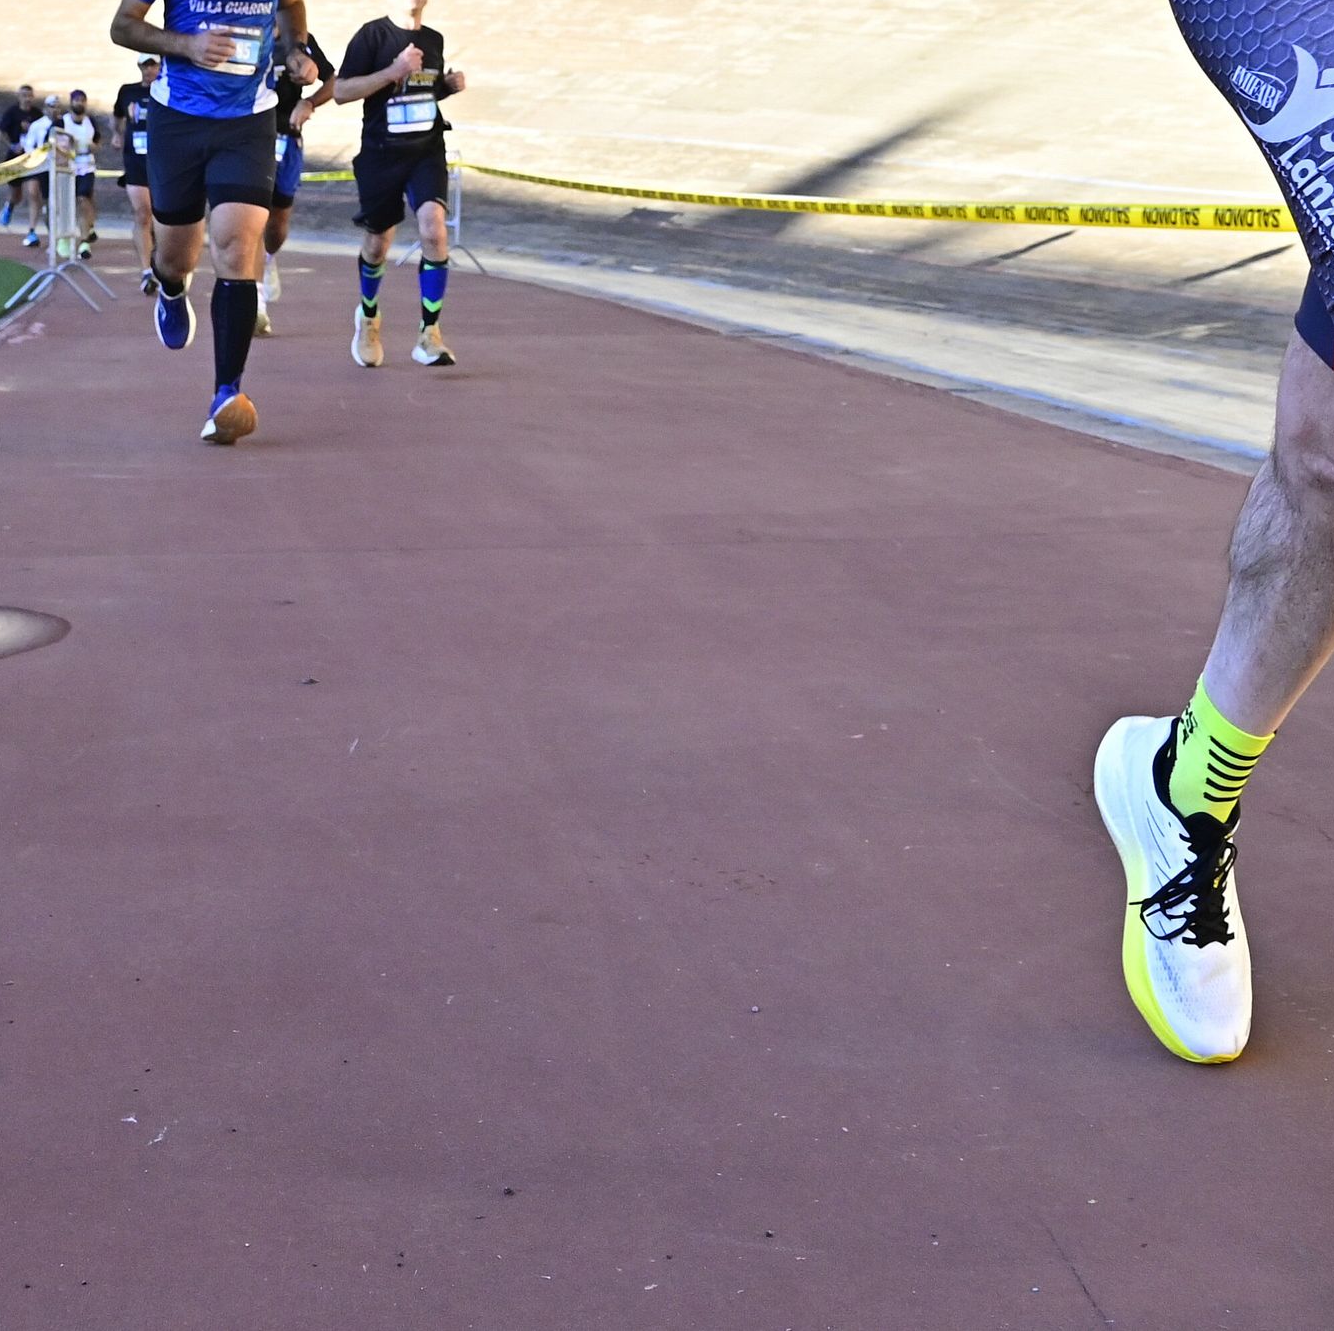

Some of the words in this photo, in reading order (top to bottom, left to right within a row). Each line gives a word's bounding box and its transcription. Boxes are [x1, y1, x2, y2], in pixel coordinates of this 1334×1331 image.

[1080, 206, 1130, 225] SALOMON
[1142, 207, 1200, 226] SALOMON
[1214, 208, 1281, 228] SALOMON
